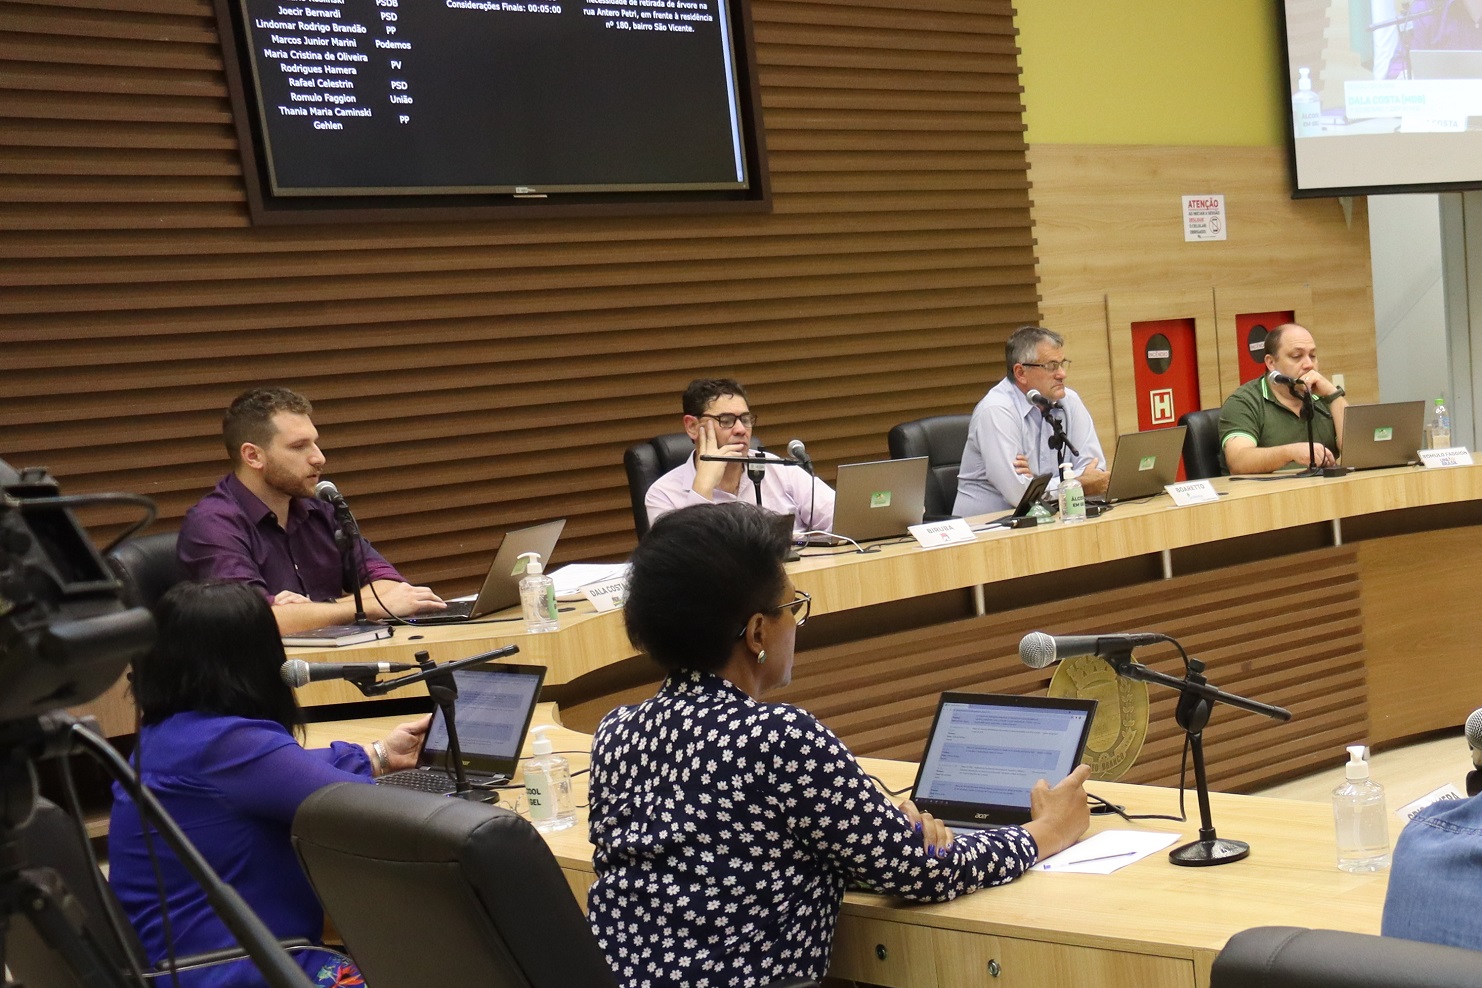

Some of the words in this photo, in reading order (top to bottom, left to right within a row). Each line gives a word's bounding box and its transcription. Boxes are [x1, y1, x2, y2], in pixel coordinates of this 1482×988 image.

[446, 0, 500, 11] Considerações
[501, 2, 526, 12] Finais:
[527, 4, 562, 14] 00:05:00
[639, 0, 665, 8] retirada
[666, 0, 675, 8] de
[676, 0, 698, 9] árvore
[277, 6, 303, 16] Joecir
[304, 7, 342, 18] Bernardi
[380, 12, 398, 21] PSD
[583, 8, 596, 16] rua
[596, 8, 620, 17] Antero
[620, 9, 639, 19] Petri,
[652, 10, 673, 20] frente
[680, 12, 713, 22] residência
[255, 19, 297, 30] Lindomar
[298, 22, 331, 34] Rodrigo
[332, 23, 367, 34] Brandão
[386, 26, 397, 35] PP
[605, 20, 614, 29] nº
[615, 21, 631, 31] 180,
[632, 22, 653, 31] bairro
[654, 22, 668, 32] São
[668, 23, 695, 33] Vicente.
[271, 34, 302, 45] Marcos
[303, 36, 330, 47] Junior
[330, 37, 357, 48] Marini
[375, 40, 412, 50] Podemos
[263, 49, 289, 59] Maria
[290, 50, 323, 61] Cristina
[324, 51, 336, 61] de
[336, 52, 369, 62] Oliveira
[280, 63, 323, 75] Rodrigues
[324, 65, 358, 75] Hamera
[390, 60, 402, 70] PV
[288, 78, 316, 88] Rafael
[317, 79, 354, 89] Celestrin
[391, 81, 408, 90] PSD
[290, 92, 323, 102] Romulo
[324, 93, 357, 105] Faggion
[390, 95, 414, 104] União
[1348, 95, 1371, 105] DALA
[1372, 95, 1400, 105] COSTA
[278, 106, 308, 116] Thania
[309, 106, 333, 117] Maria
[334, 107, 373, 117] Caminski
[313, 120, 344, 130] Gehlen
[399, 115, 410, 124] PP
[1188, 197, 1219, 210] ATENÇÃO
[1153, 393, 1172, 419] H
[1174, 483, 1206, 494] BOARETTO
[926, 524, 954, 534] BIRUBA
[589, 586, 609, 598] DALA
[974, 811, 990, 820] acer
